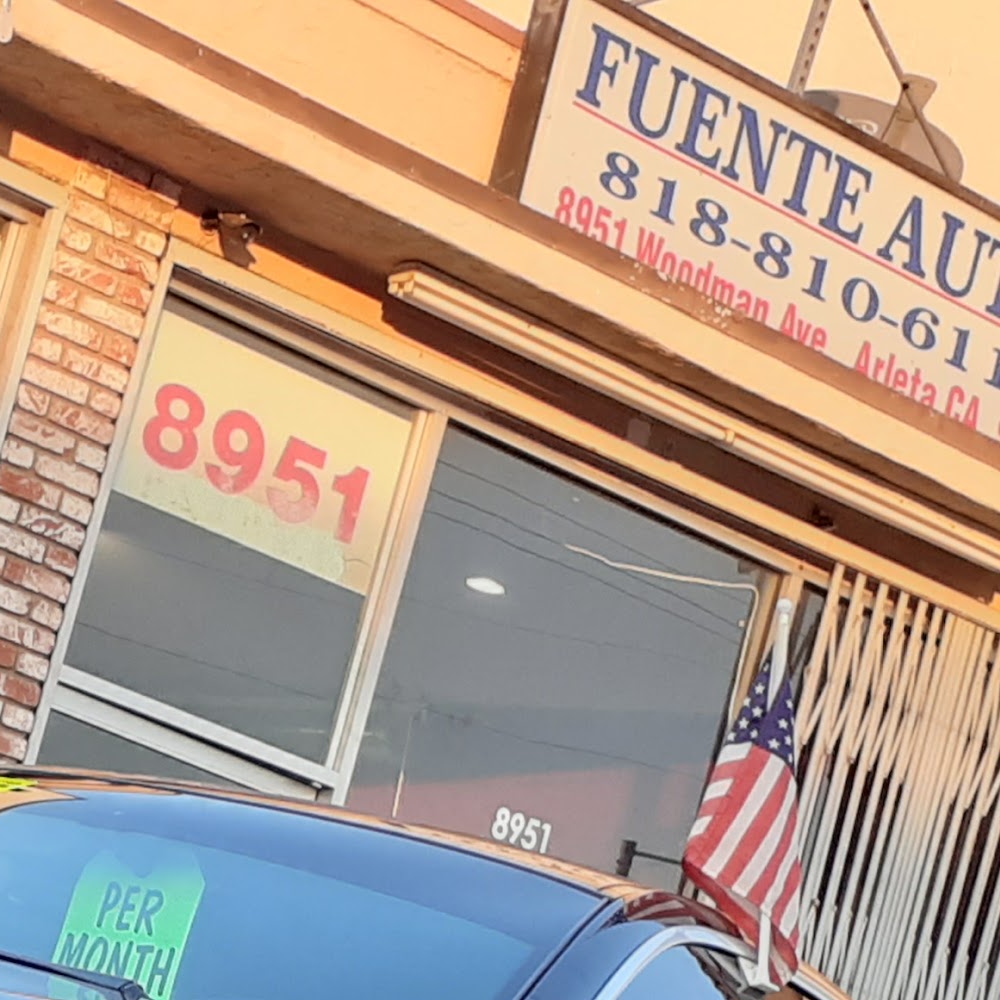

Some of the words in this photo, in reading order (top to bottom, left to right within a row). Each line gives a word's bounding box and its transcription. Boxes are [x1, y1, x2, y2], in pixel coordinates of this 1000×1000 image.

[575, 23, 872, 244] FUENTE
[555, 186, 628, 252] 8951
[780, 303, 828, 351] Ave
[854, 340, 937, 412] Arleta
[945, 384, 980, 430] CA
[143, 383, 370, 544] 8951
[491, 806, 552, 854] 8951
[58, 931, 177, 997] MONTH
[96, 880, 165, 937] PER
